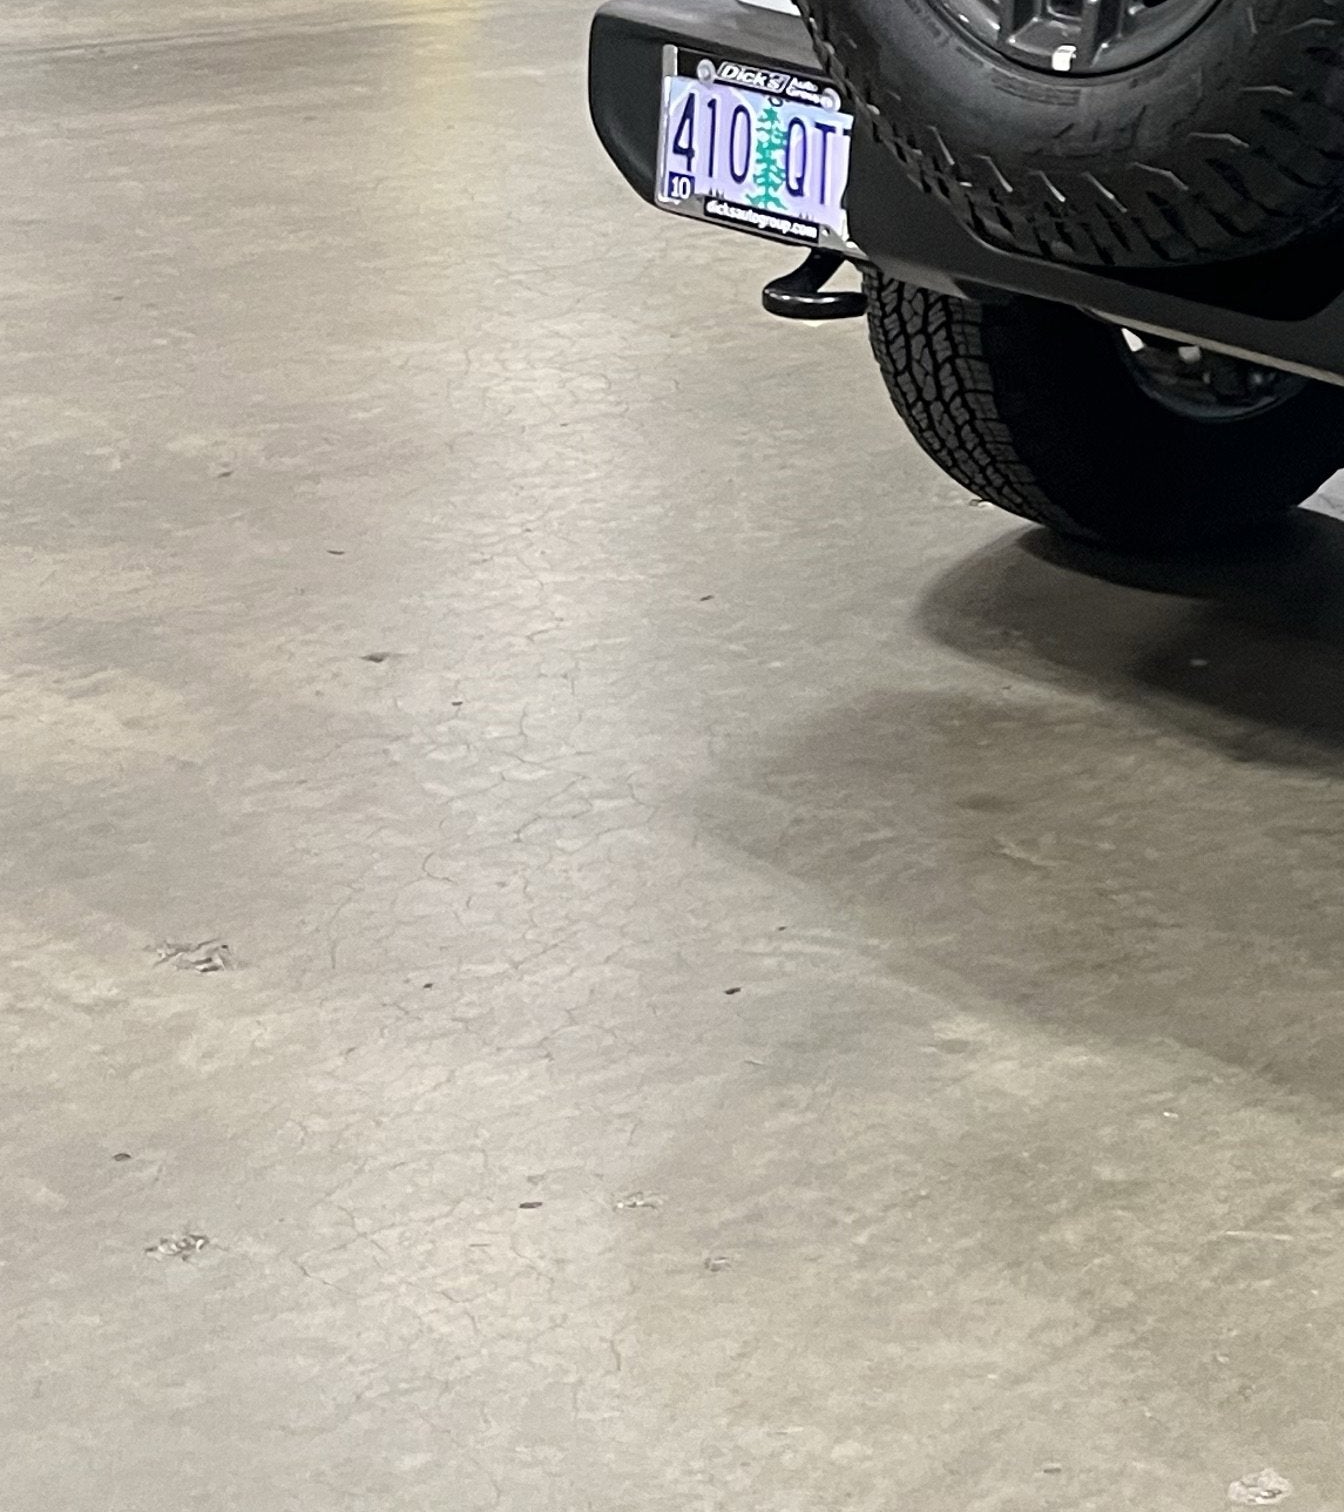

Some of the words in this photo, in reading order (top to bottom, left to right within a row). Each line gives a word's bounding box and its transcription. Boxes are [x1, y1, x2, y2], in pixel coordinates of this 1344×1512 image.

[672, 92, 750, 184] 410
[785, 116, 853, 205] QT
[669, 176, 692, 200] 10
